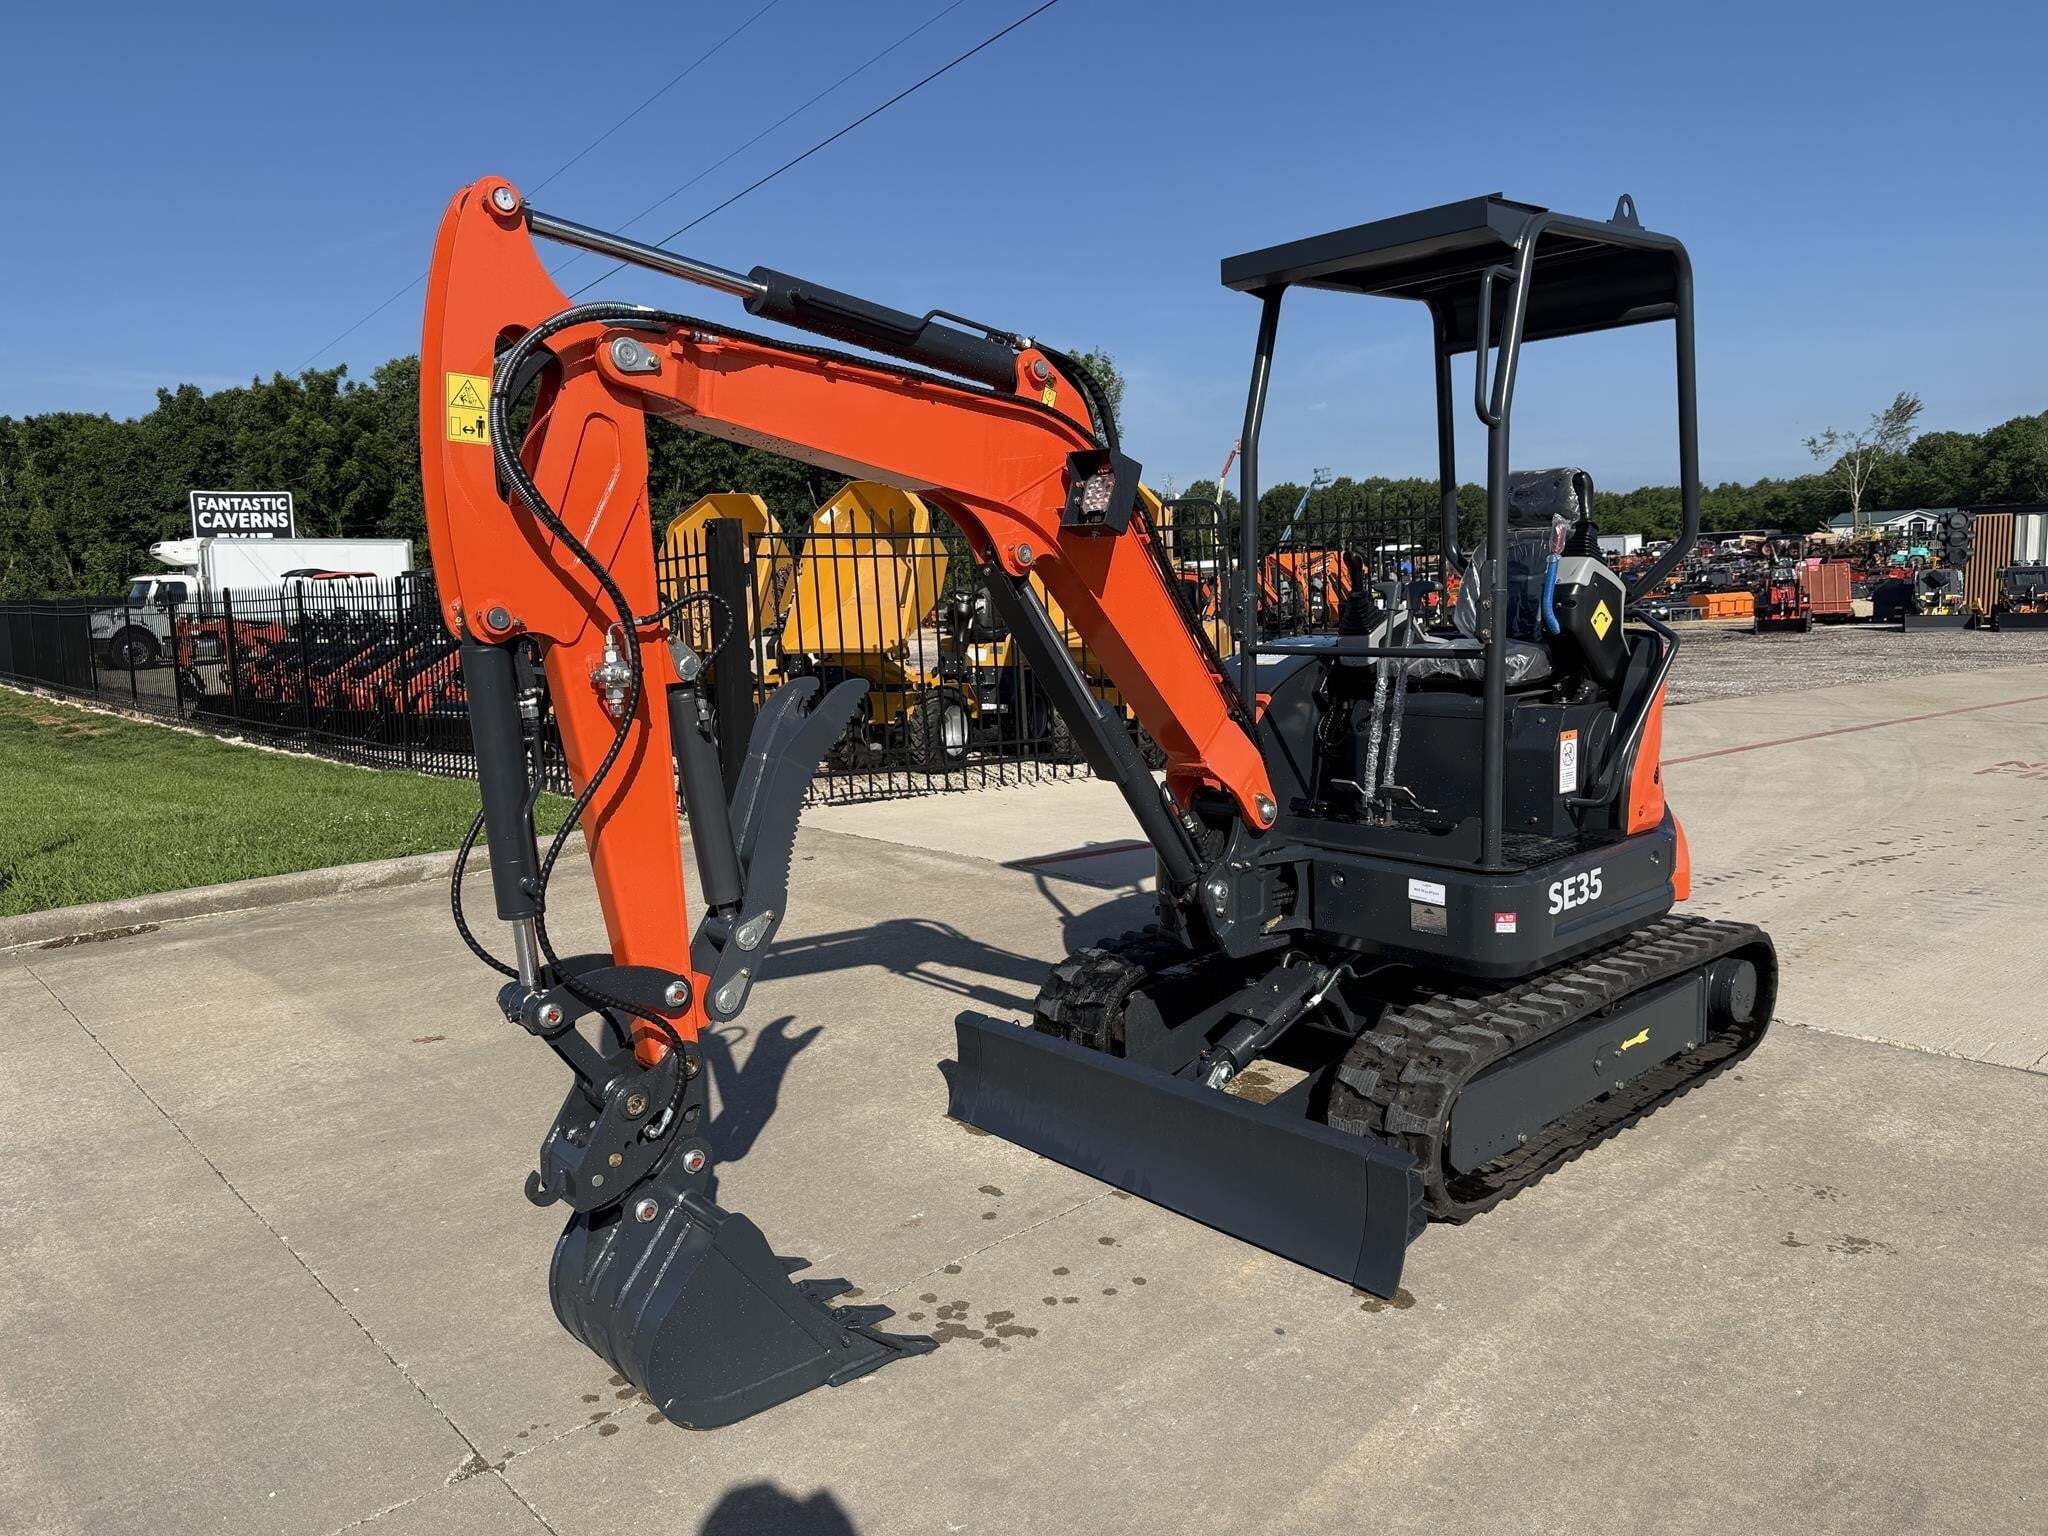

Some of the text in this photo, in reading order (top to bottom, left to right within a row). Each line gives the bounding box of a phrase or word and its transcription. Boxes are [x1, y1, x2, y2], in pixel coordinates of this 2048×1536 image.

[197, 497, 288, 511] FANTASTIC
[198, 512, 289, 528] CAVERNS
[1548, 867, 1603, 915] SE35
